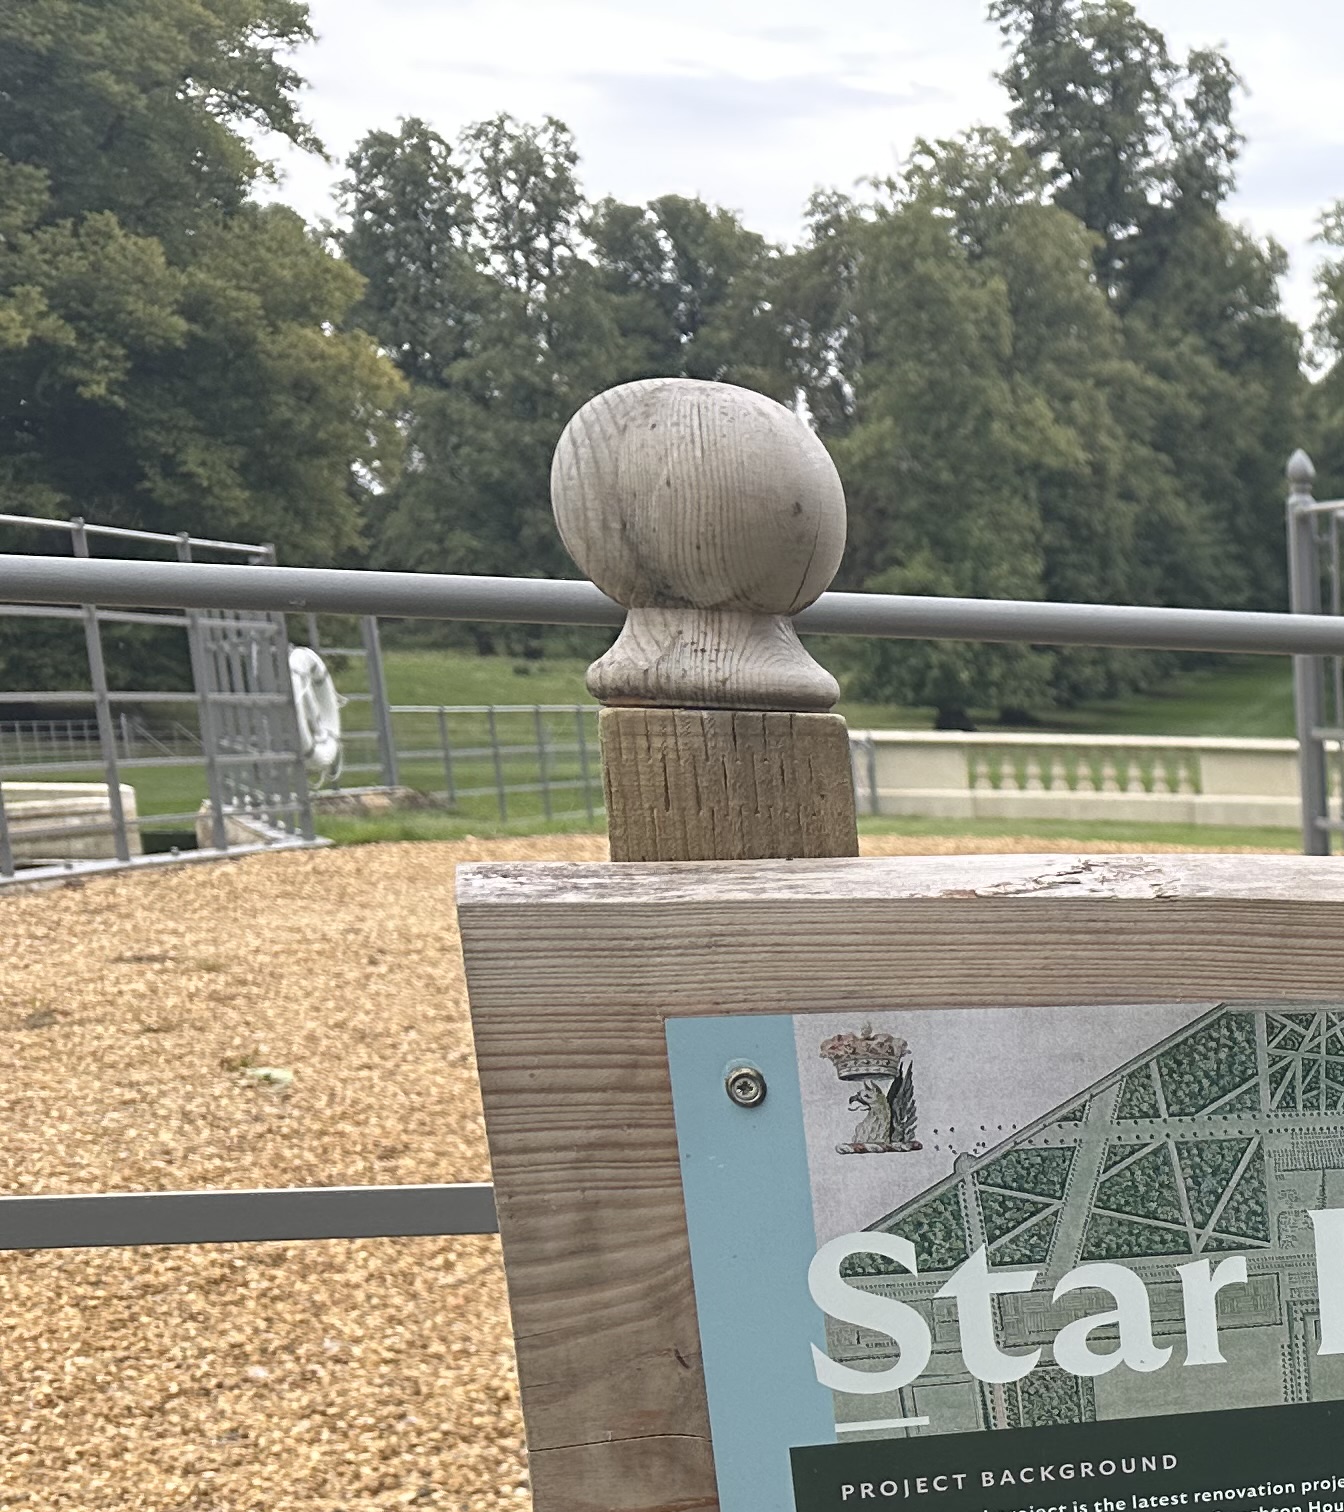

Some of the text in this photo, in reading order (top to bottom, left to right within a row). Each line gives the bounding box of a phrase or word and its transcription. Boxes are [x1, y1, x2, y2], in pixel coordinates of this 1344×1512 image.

[807, 1230, 1247, 1396] Star
[841, 1454, 1177, 1501] PROJECT BACKGROUND
[1093, 1497, 1127, 1512] the
[1131, 1492, 1189, 1509] latest
[1193, 1481, 1296, 1503] renovation
